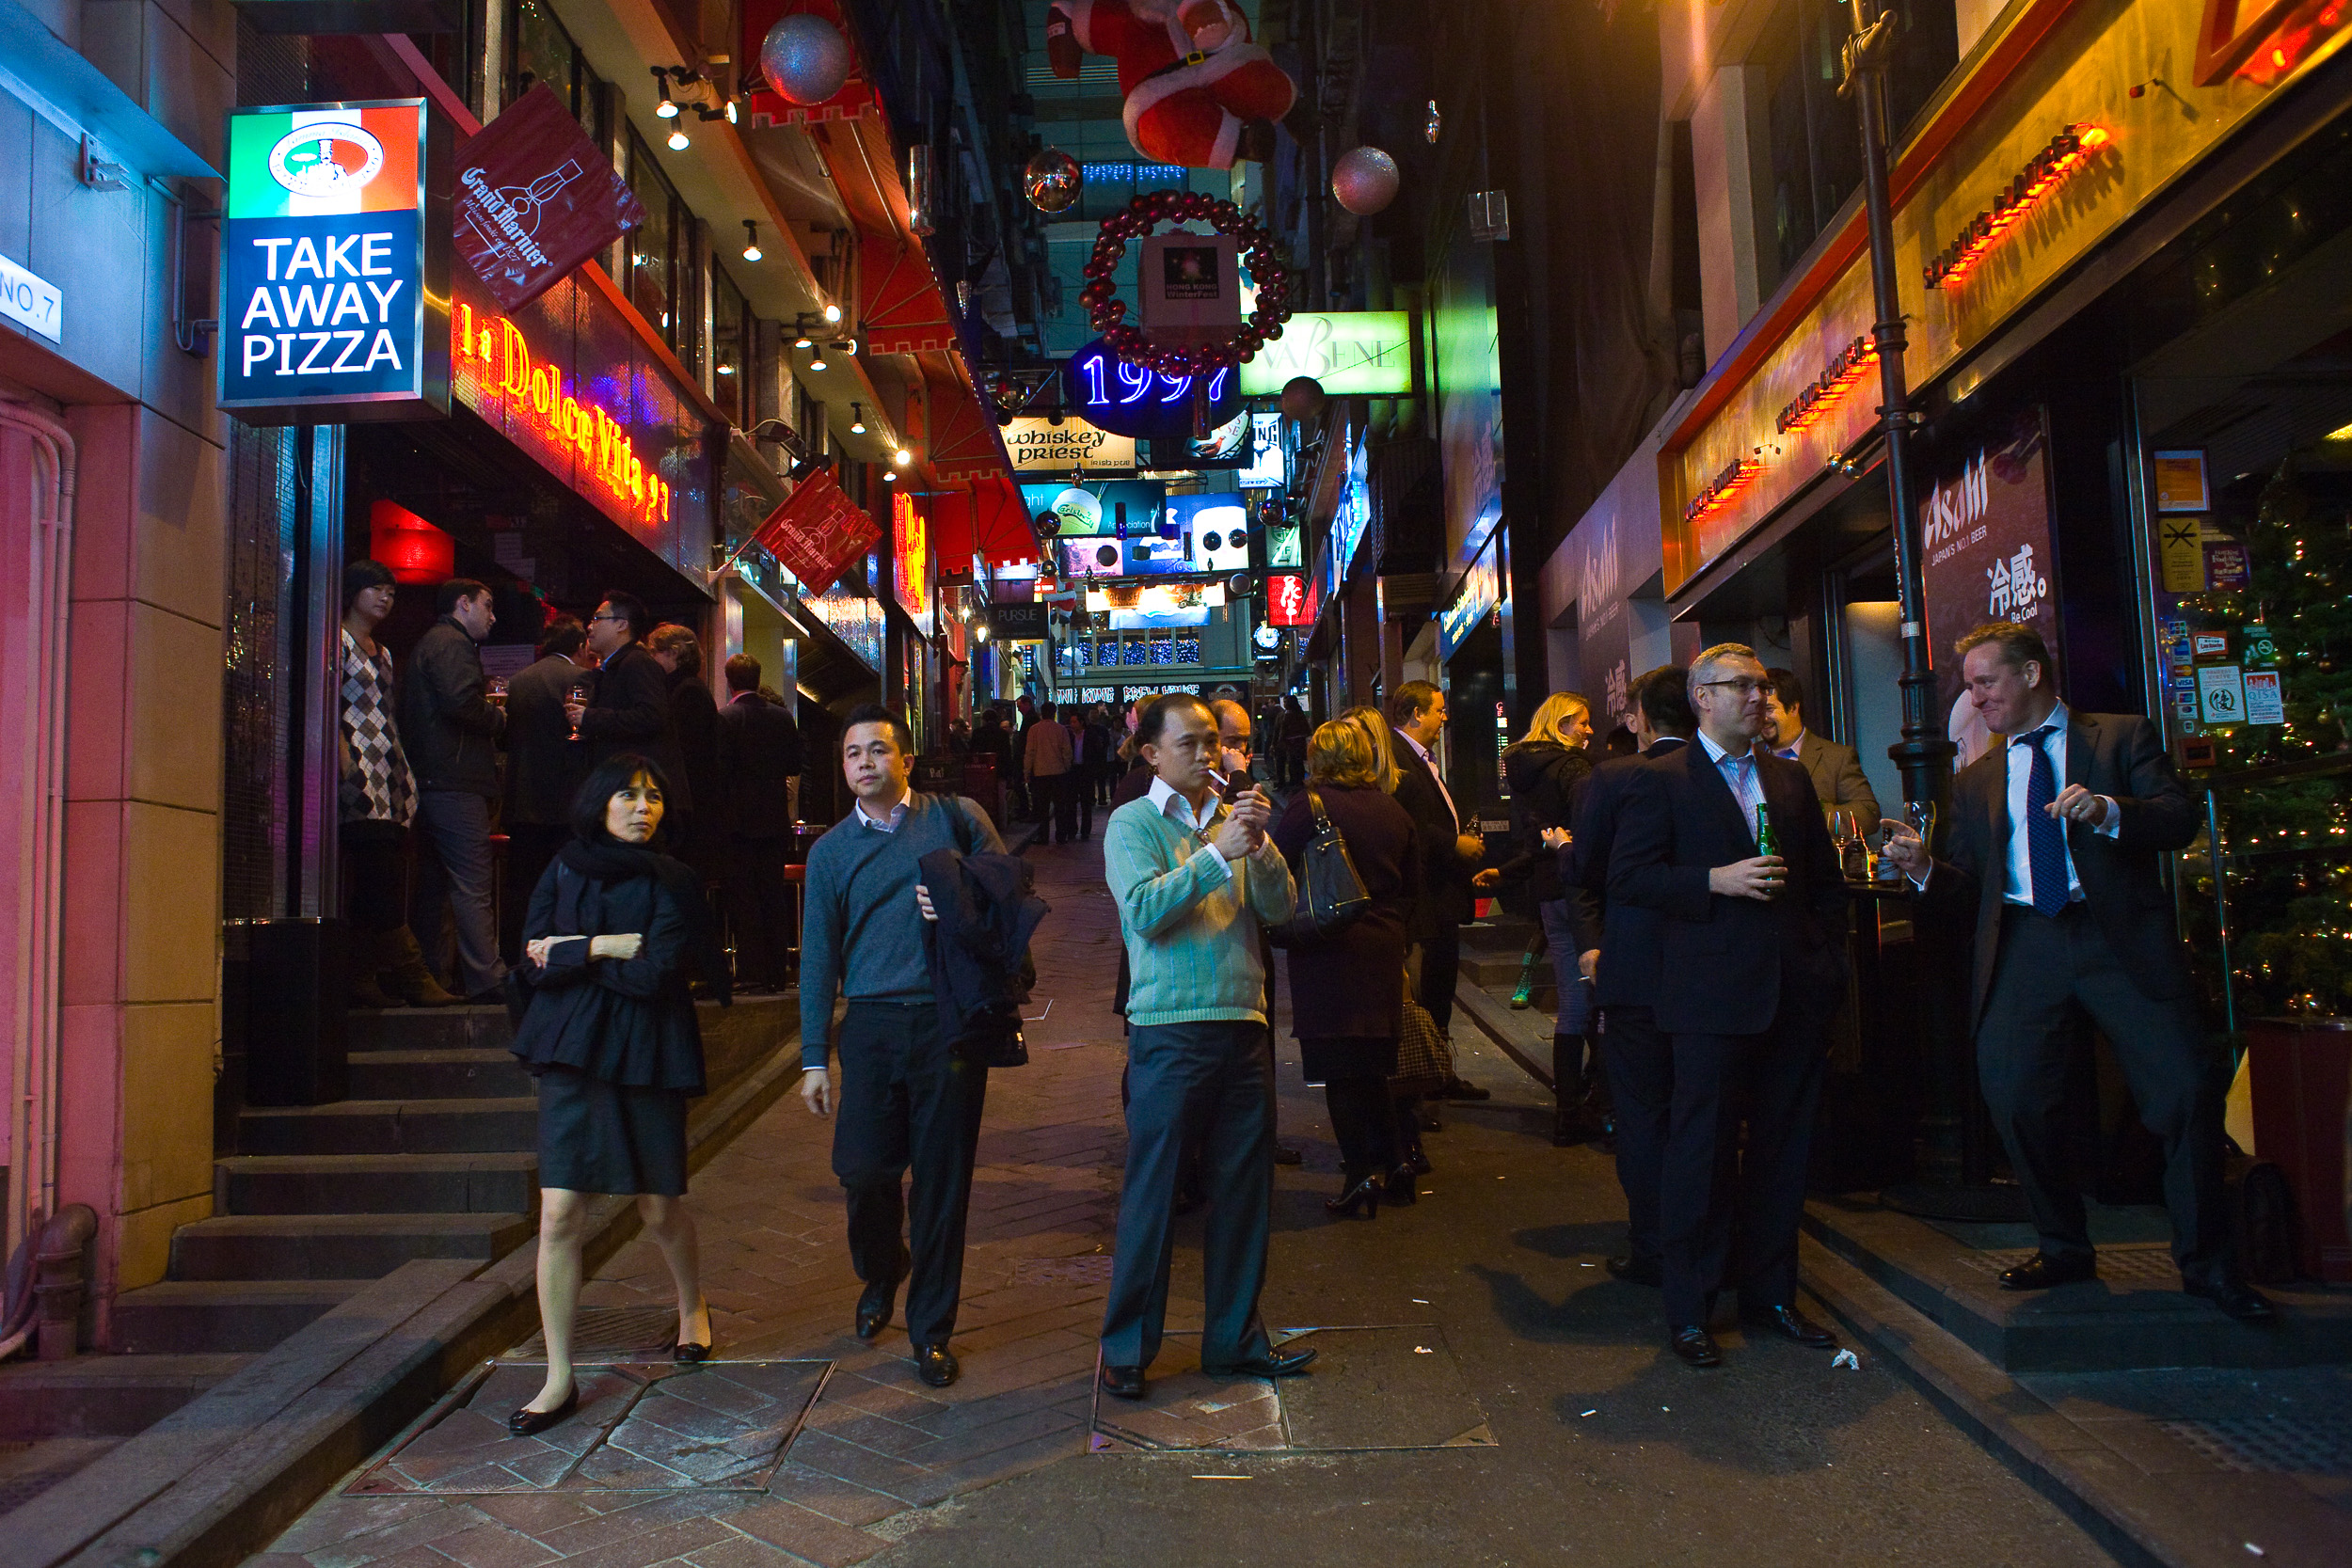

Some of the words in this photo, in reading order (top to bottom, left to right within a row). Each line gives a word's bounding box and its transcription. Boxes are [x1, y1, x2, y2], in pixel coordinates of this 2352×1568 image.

[461, 166, 505, 214] Grand
[490, 203, 548, 267] Marnier
[252, 231, 393, 281] TAKE
[241, 279, 404, 329] AWAY
[1167, 290, 1218, 298] WinterFest
[243, 328, 403, 377] PIZZA
[495, 316, 594, 454] Dolce
[594, 404, 644, 501] Vita
[1007, 430, 1106, 448] whiskey
[1017, 444, 1094, 464] priest
[1923, 445, 1989, 550] Asahi
[780, 518, 806, 543] Grand
[799, 536, 833, 571] Marnier
[1581, 512, 1618, 623] Asahi
[1931, 543, 1956, 567] JAPAN'S
[1970, 524, 1988, 545] BEER
[998, 609, 1038, 622] PURSUE
[2010, 610, 2022, 625] Be
[2021, 602, 2039, 622] Cool
[1081, 687, 1115, 704] KONG
